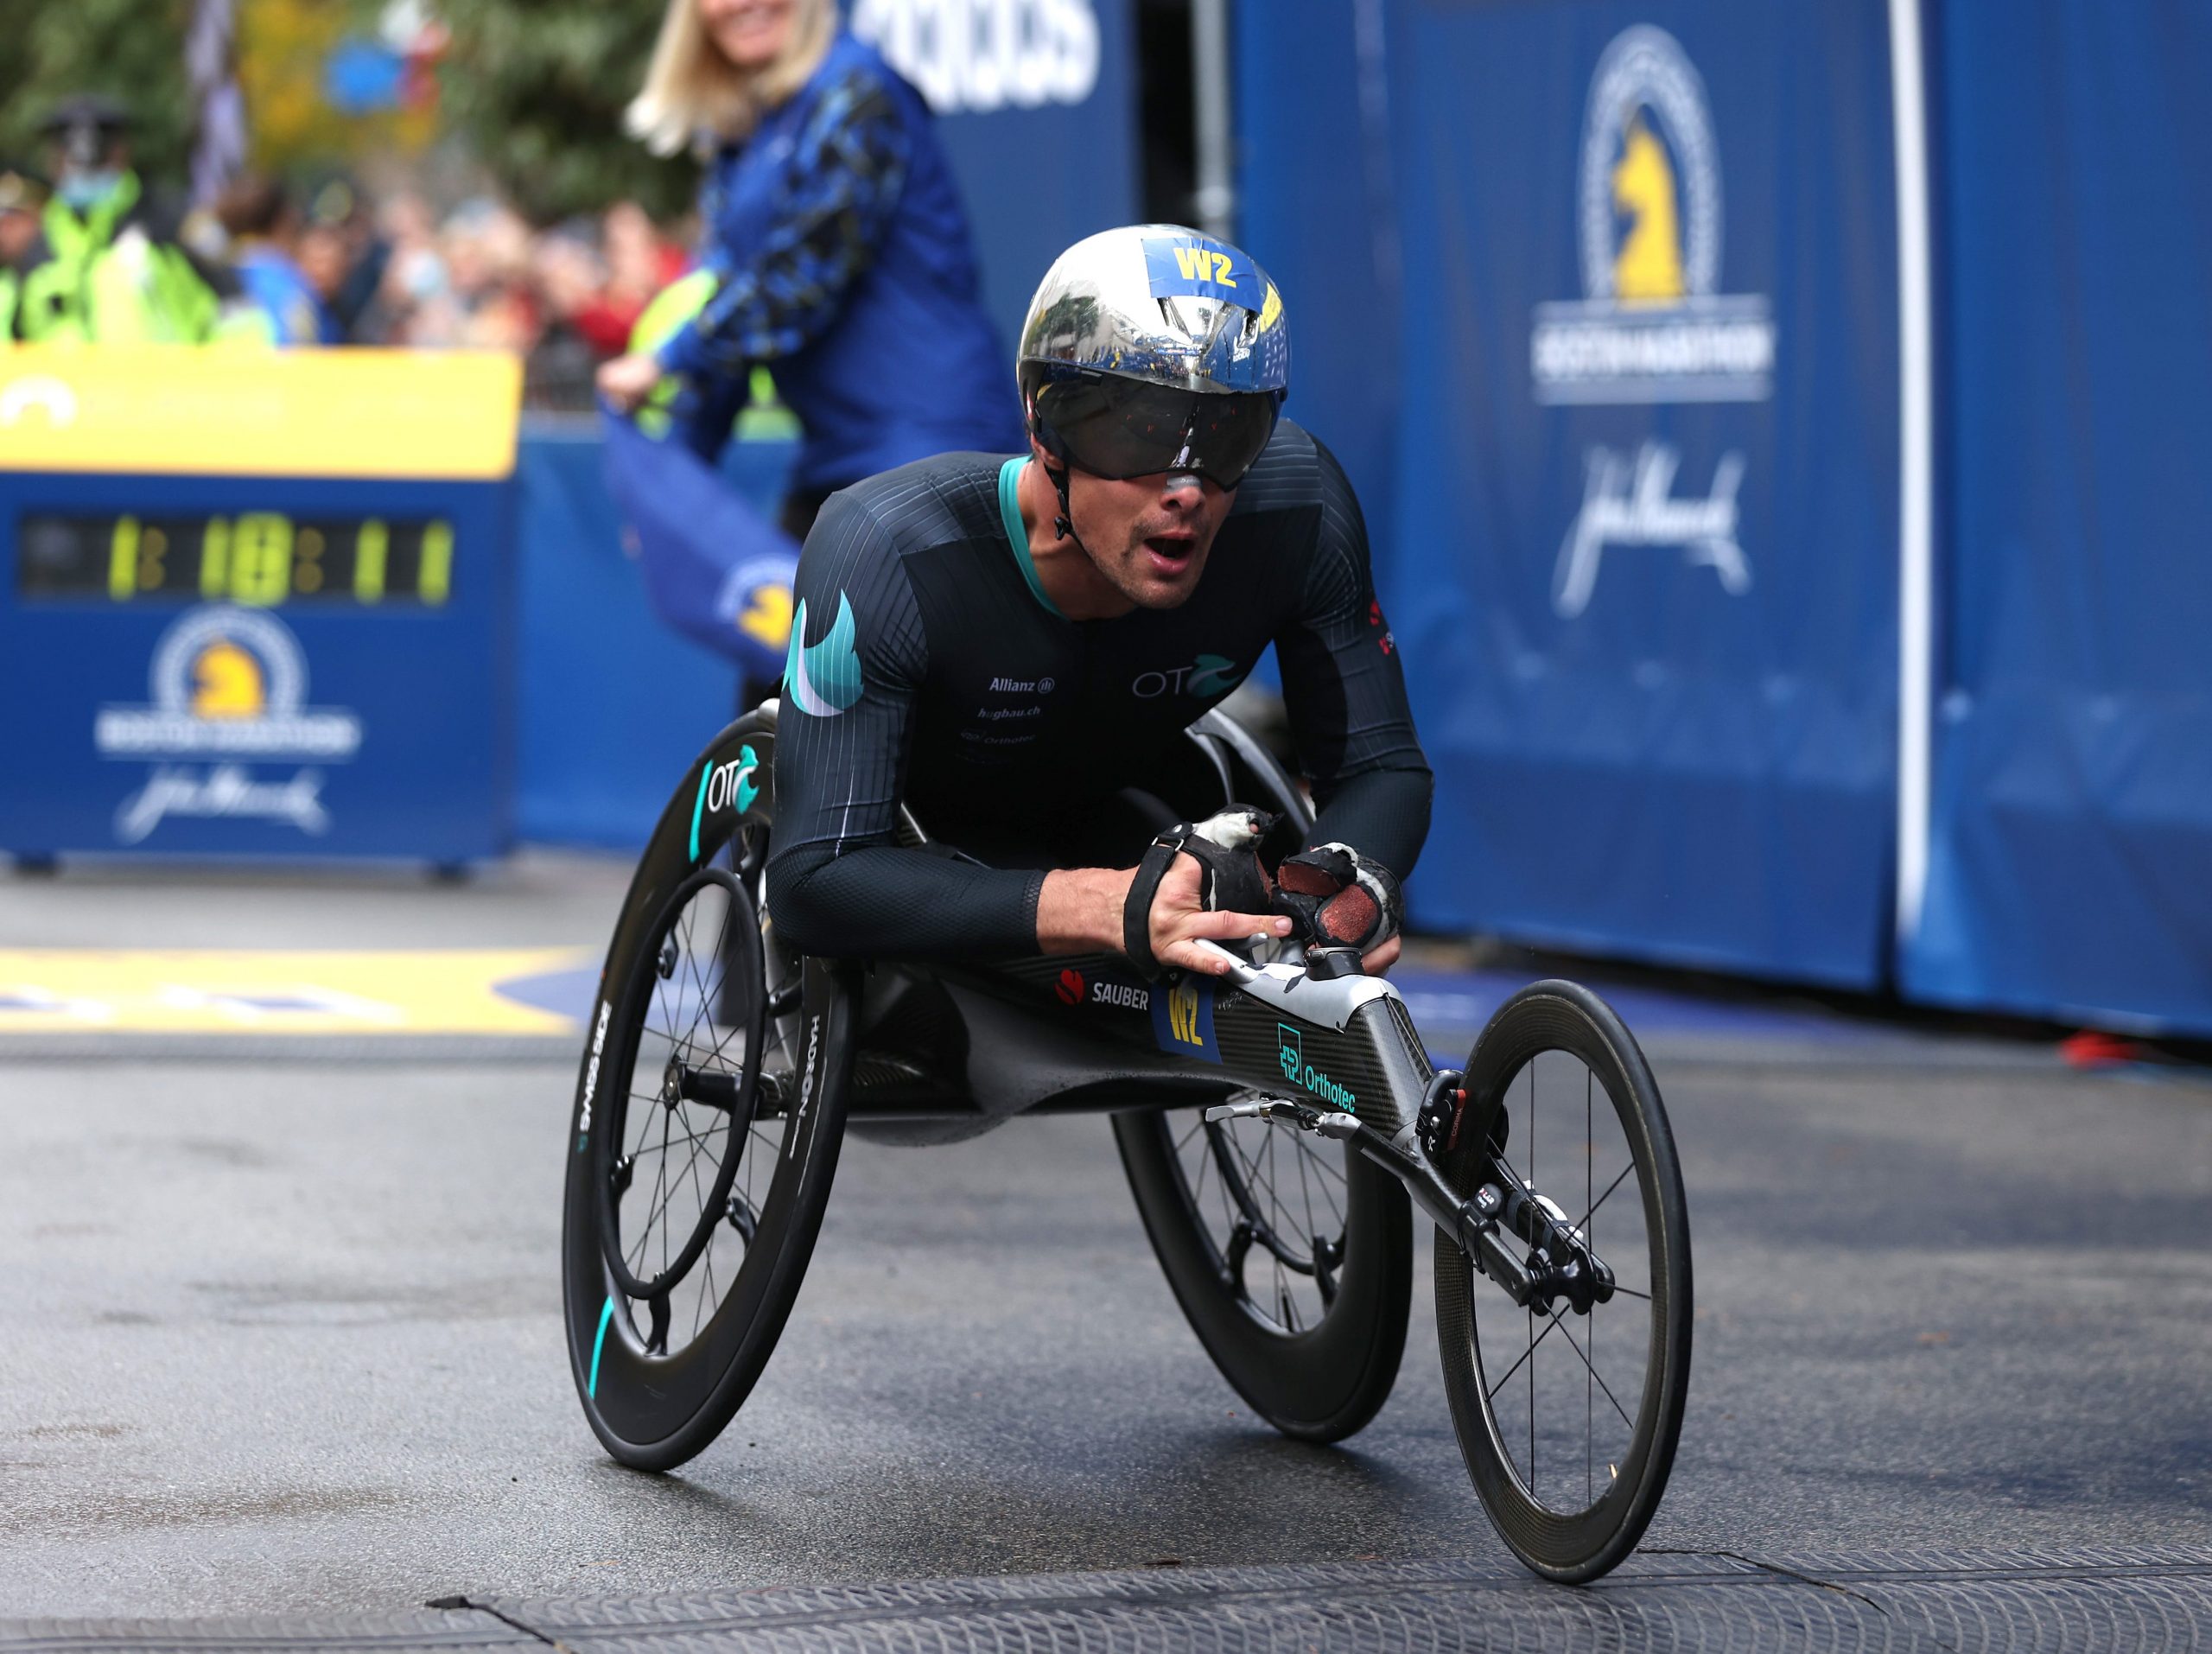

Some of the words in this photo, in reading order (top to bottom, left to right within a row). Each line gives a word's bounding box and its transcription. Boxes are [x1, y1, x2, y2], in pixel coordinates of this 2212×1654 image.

[1173, 246, 1237, 288] W2
[988, 677, 1035, 692] Allianz
[977, 706, 1041, 721] hugbau.ch
[1091, 982, 1149, 1011] SAUBER
[1169, 986, 1204, 1046] W2
[580, 1056, 601, 1132] SWISS
[593, 999, 613, 1056] SIDE
[798, 1015, 820, 1117] HADRON
[1305, 1065, 1356, 1113] Orthotec
[1452, 1107, 1464, 1136] CORIMA
